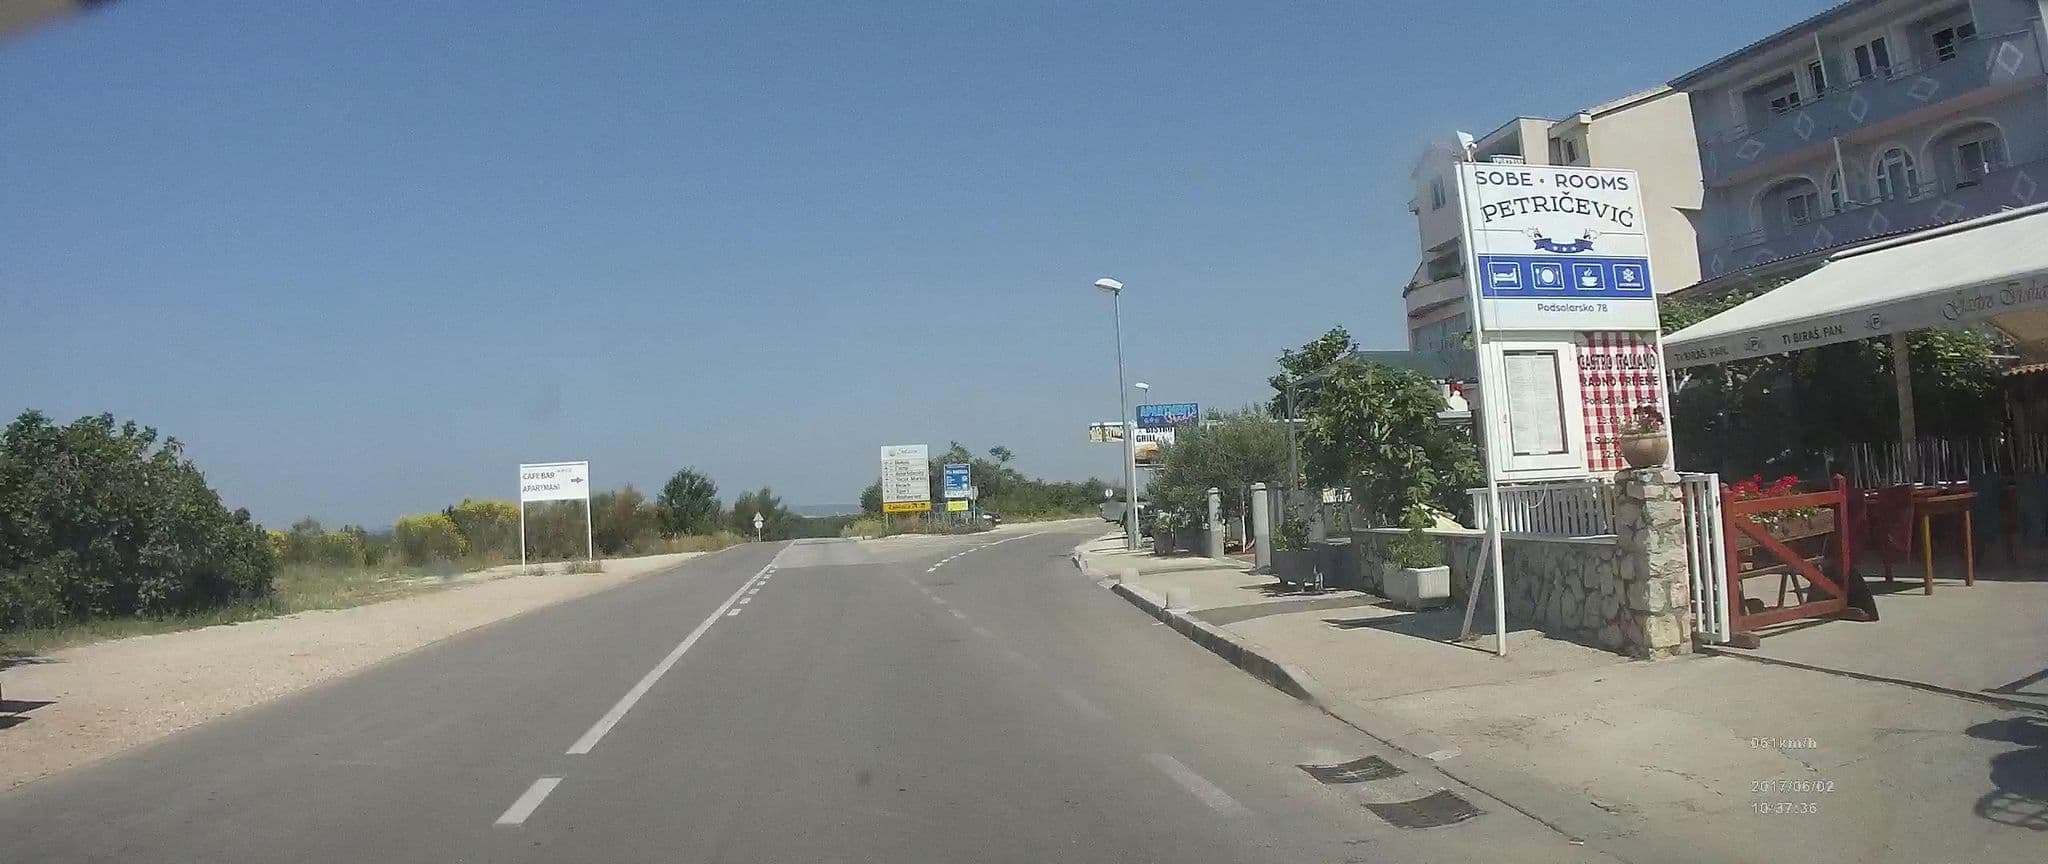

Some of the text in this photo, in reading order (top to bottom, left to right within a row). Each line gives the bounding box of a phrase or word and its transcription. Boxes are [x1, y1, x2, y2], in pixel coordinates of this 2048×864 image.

[1475, 170, 1629, 191] SOBE ROOMS
[1480, 191, 1634, 227] PETRIČEVIĆ
[1597, 303, 1608, 313] 78
[1616, 353, 1656, 370] ITALIANO
